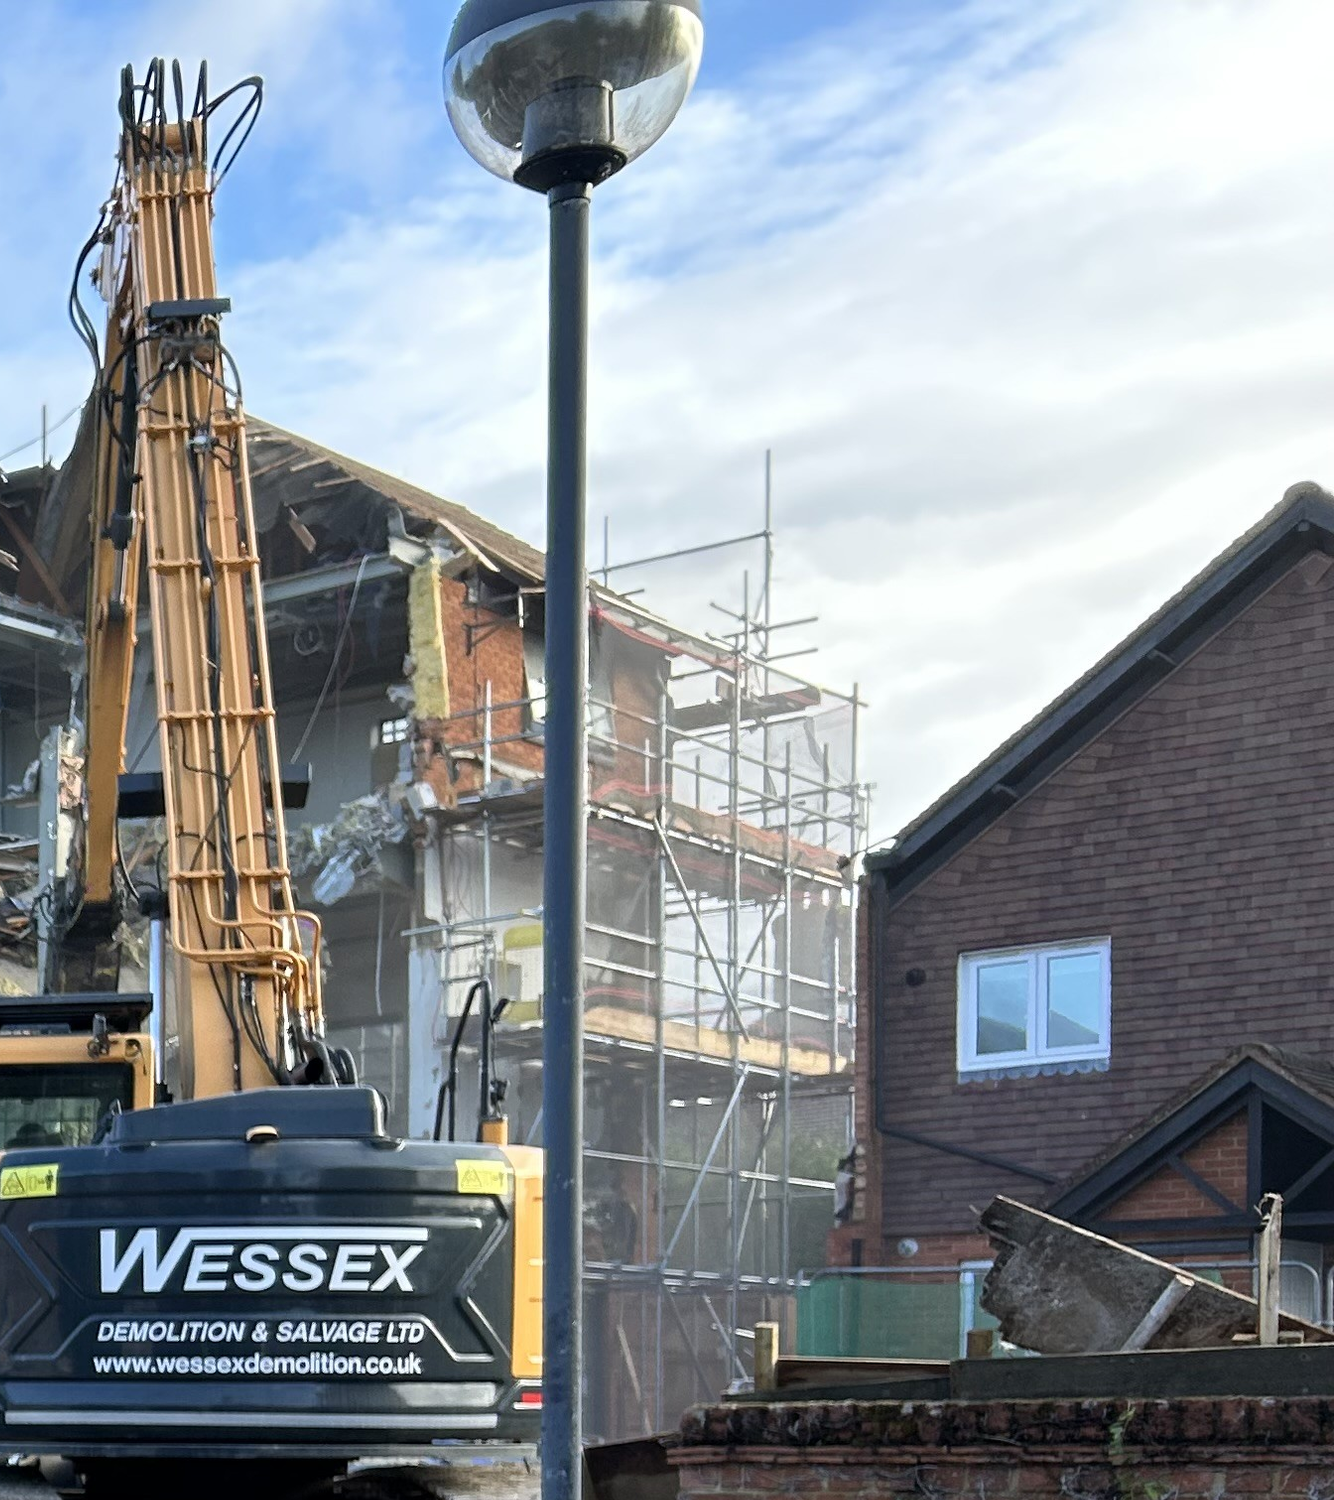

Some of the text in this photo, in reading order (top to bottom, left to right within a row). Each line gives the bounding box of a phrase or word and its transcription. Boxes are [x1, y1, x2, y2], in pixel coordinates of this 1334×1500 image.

[99, 1226, 429, 1293] WESSEX
[97, 1320, 425, 1343] DEMOLITION & SALVAGE LTD
[93, 1351, 422, 1375] www.wessexdemolition.co.uk
